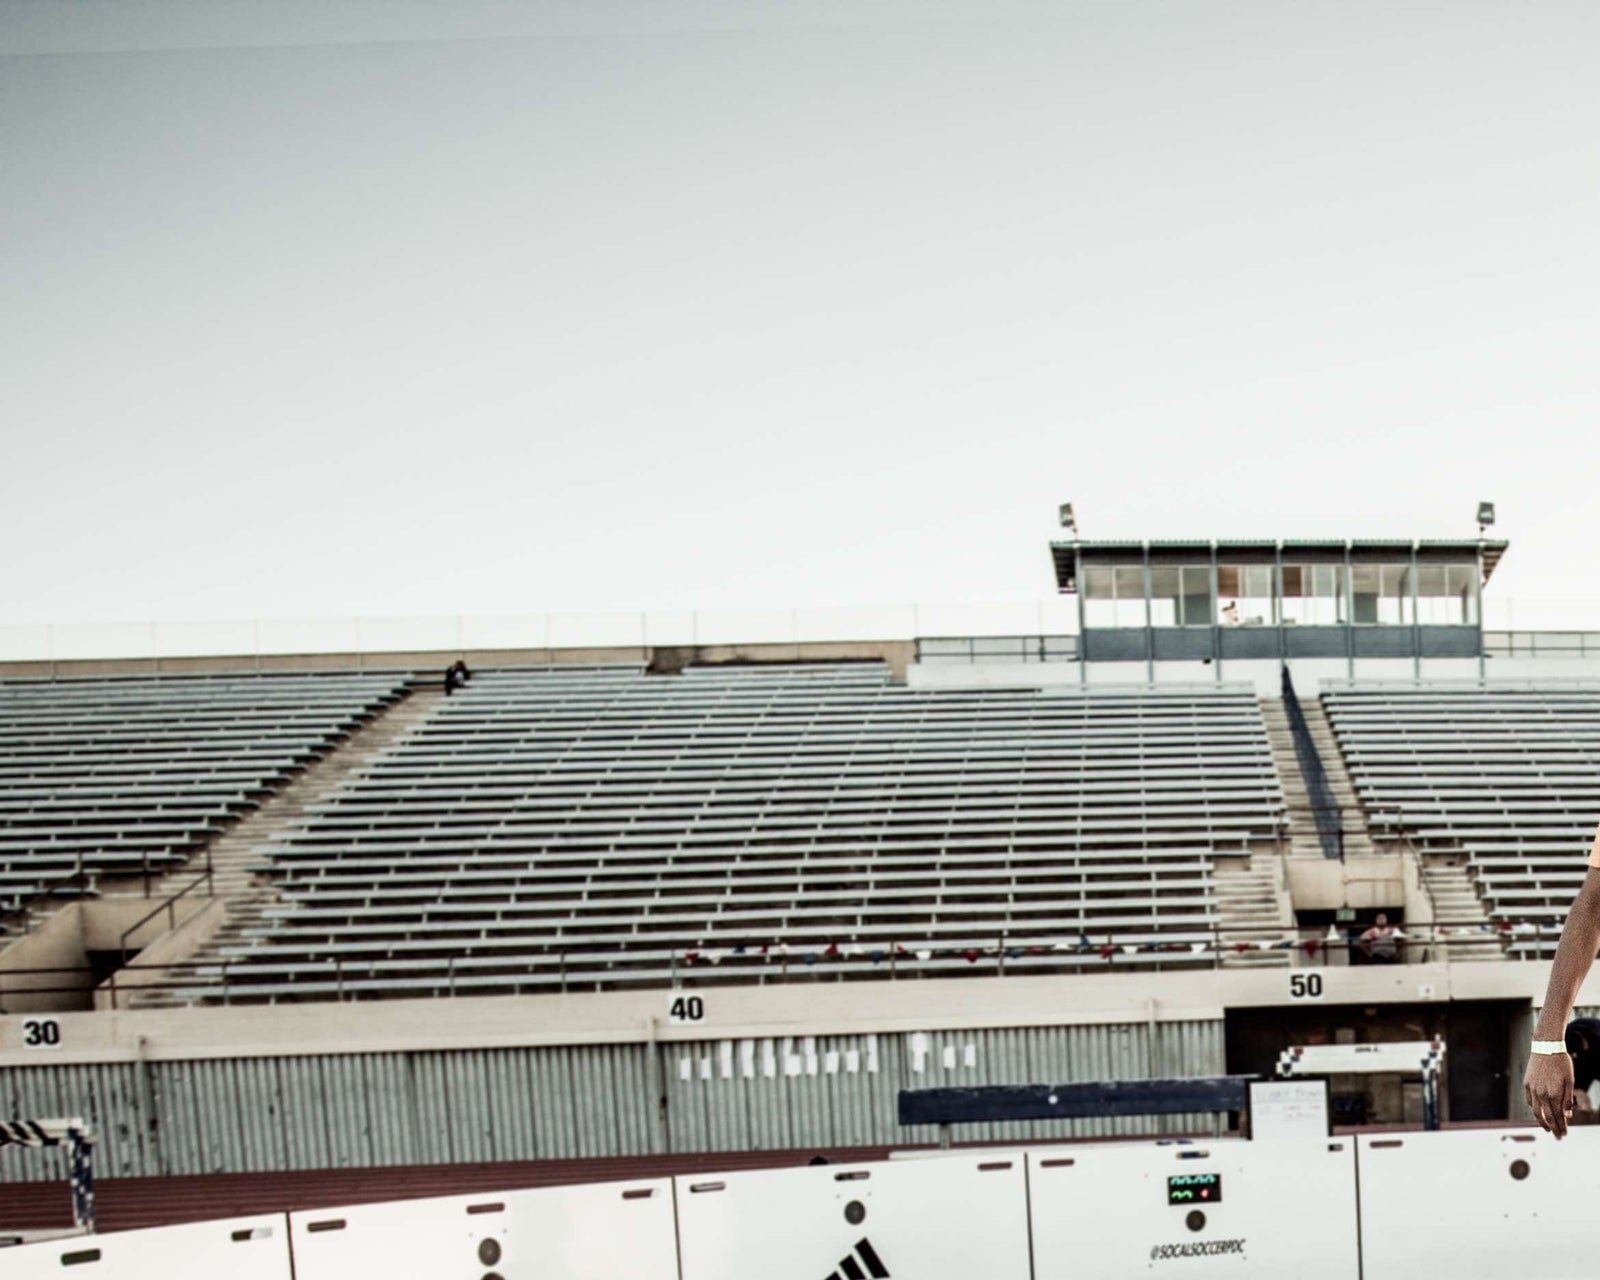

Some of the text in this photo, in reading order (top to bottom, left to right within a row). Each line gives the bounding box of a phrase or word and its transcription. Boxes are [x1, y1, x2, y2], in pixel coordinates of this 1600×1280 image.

[1290, 973, 1323, 998] 50
[669, 996, 704, 1021] 40
[24, 1020, 61, 1046] 30
